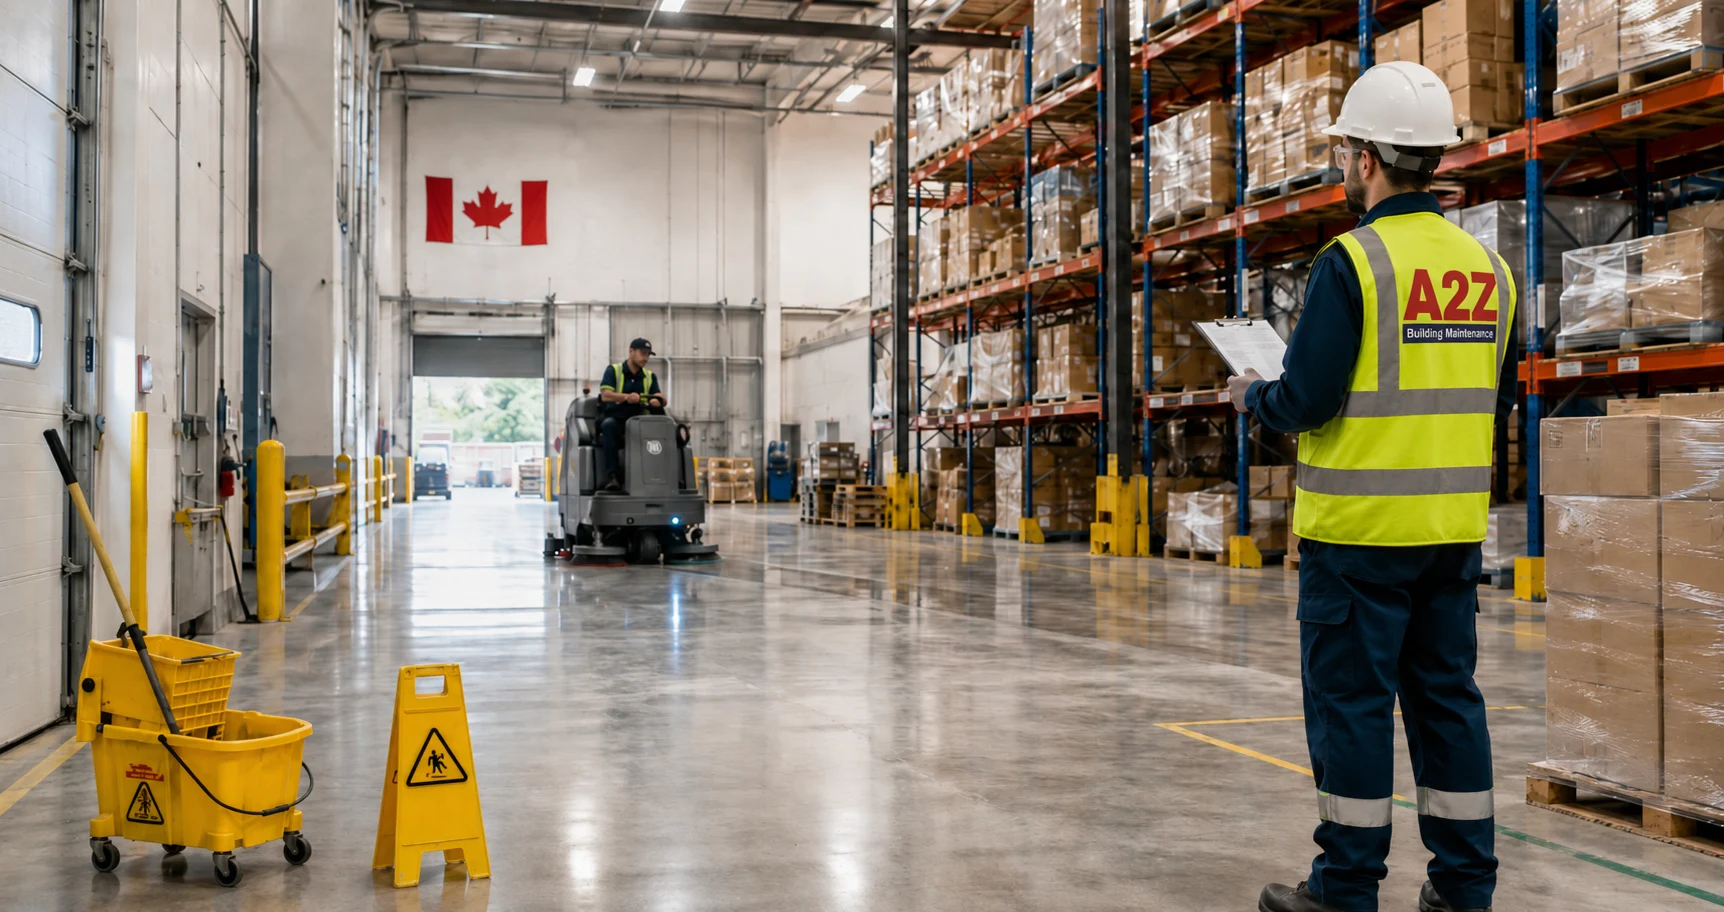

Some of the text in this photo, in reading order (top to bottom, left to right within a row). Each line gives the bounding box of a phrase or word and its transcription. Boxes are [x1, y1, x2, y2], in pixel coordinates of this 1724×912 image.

[1403, 269, 1497, 321] A2Z
[1407, 328, 1493, 340] Building Maintenance
